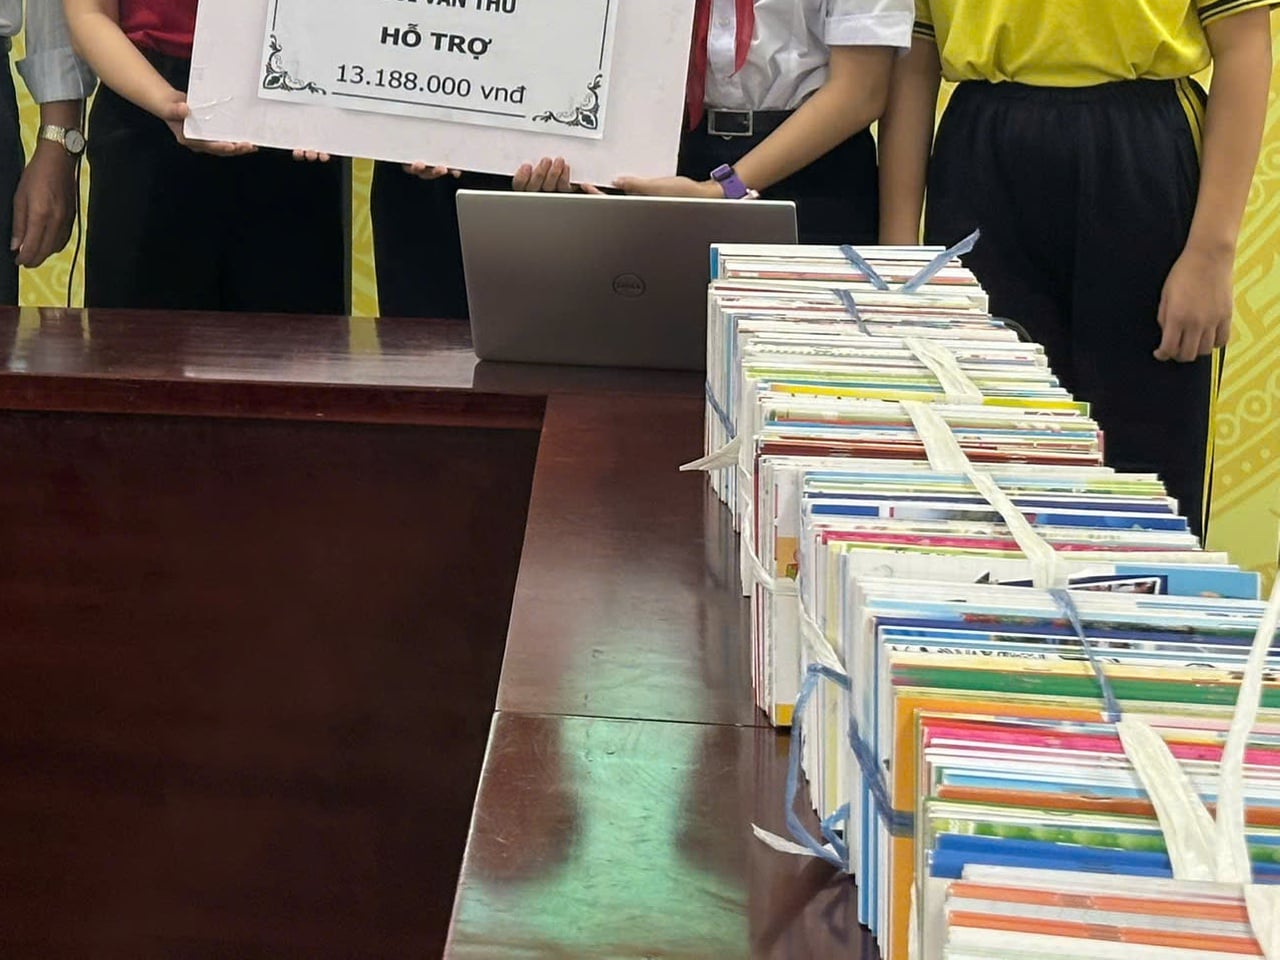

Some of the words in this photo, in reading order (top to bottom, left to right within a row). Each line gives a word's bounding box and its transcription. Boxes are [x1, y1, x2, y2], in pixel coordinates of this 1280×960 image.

[380, 23, 422, 48] HỖ
[430, 32, 492, 60] TRỢ
[336, 63, 471, 98] 13.188.000
[480, 85, 527, 104] vnđ
